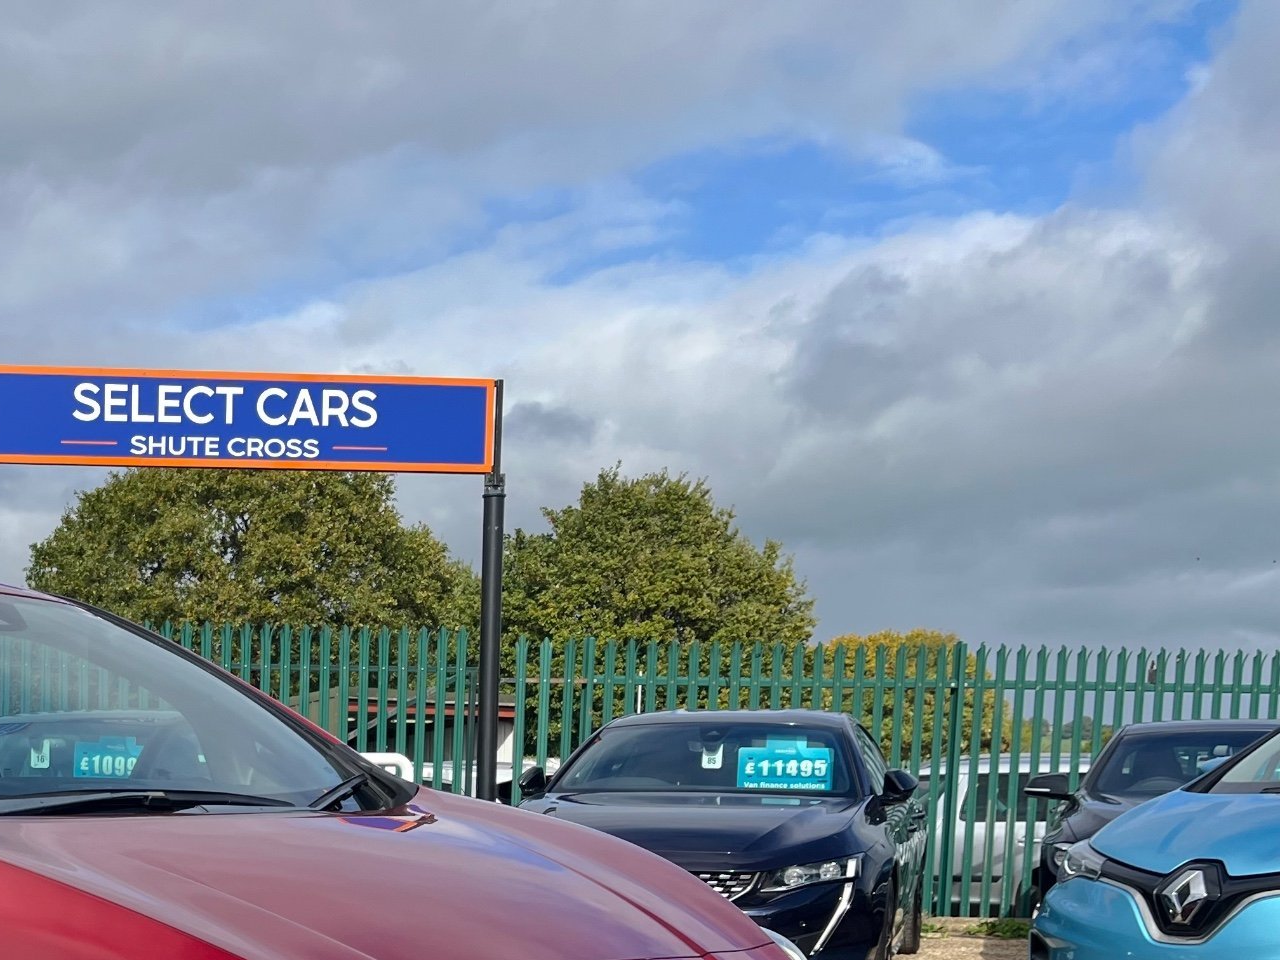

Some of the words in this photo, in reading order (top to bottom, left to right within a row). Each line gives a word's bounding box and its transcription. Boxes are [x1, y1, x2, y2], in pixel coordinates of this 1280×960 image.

[72, 382, 244, 424] SELECT
[256, 387, 378, 428] CARS
[130, 435, 220, 456] SHUTE
[227, 437, 320, 458] CROSS
[744, 781, 758, 789] Van
[760, 781, 788, 789] finance
[790, 782, 826, 790] solutions
